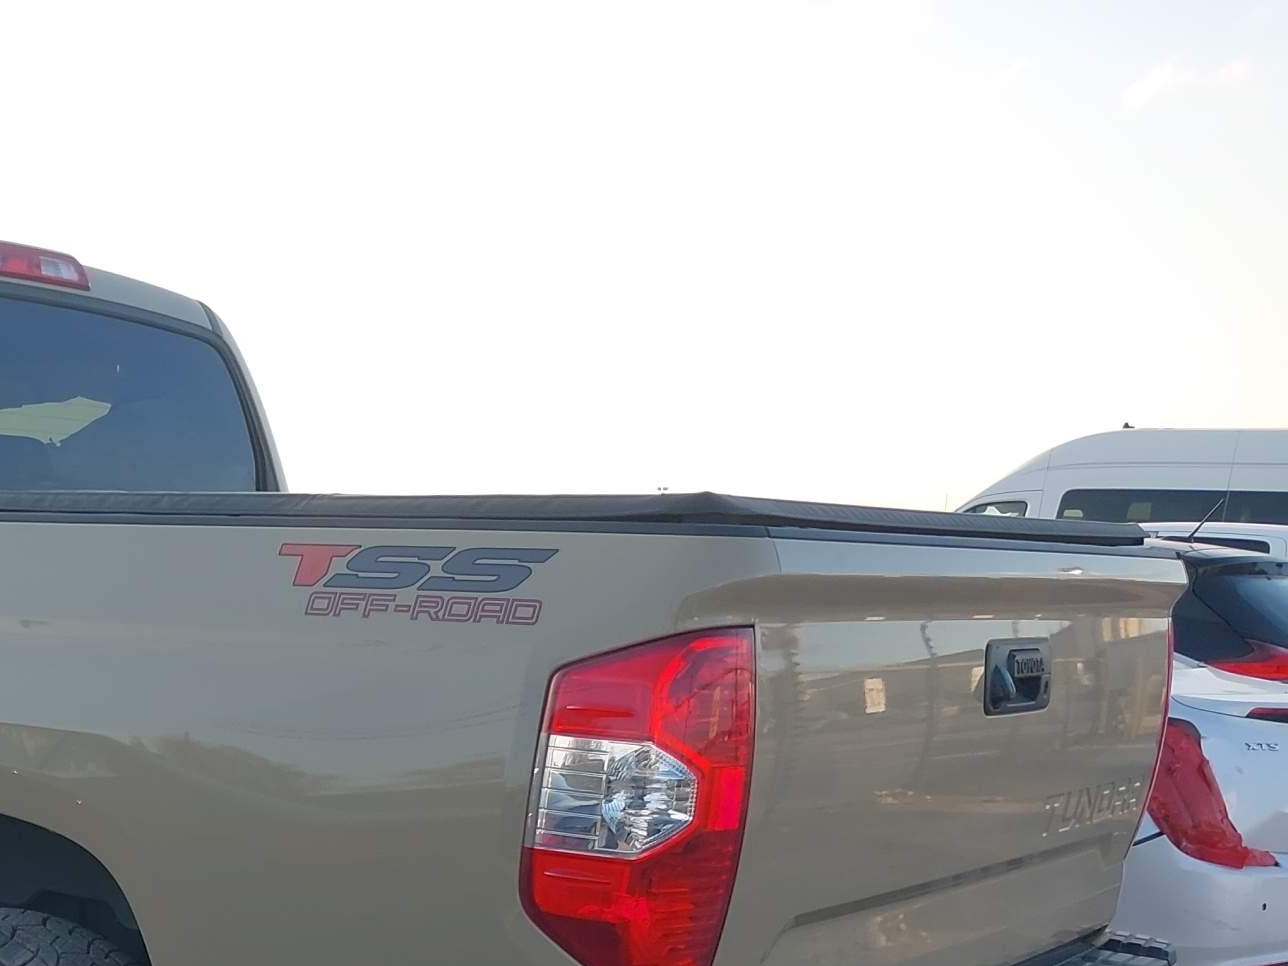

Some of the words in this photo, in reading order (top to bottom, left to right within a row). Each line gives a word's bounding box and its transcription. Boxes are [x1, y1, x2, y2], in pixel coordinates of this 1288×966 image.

[279, 543, 561, 593] TSS
[305, 591, 543, 626] OFF-ROAD
[1015, 656, 1046, 675] TOYOTA
